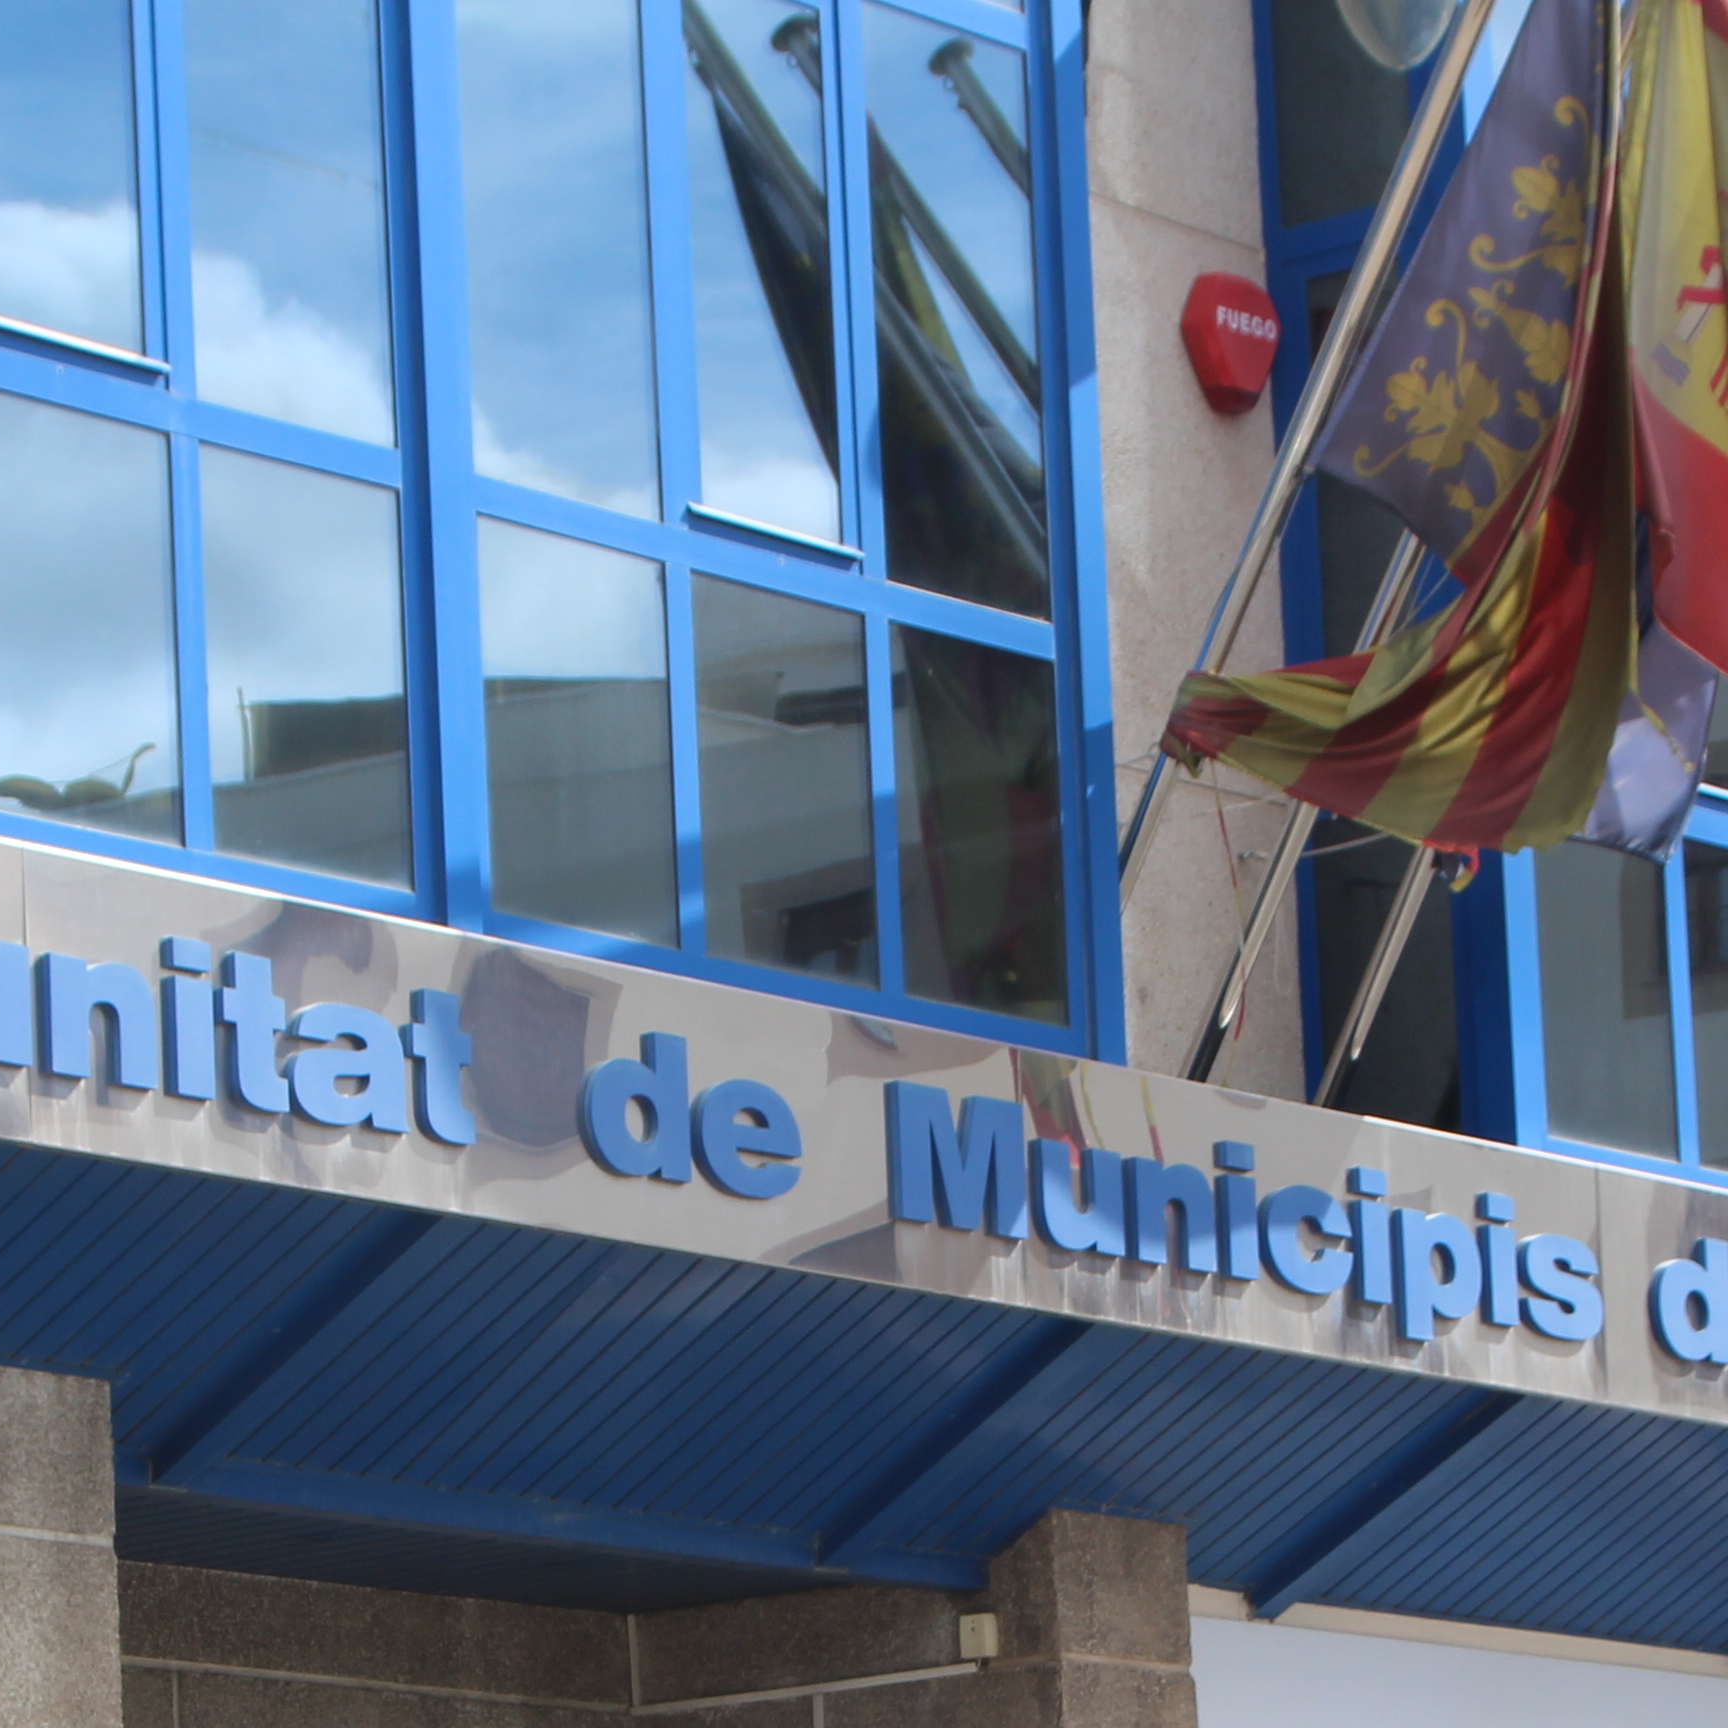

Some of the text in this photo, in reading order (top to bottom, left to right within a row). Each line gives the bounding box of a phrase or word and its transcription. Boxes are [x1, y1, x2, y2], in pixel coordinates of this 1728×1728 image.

[1216, 305, 1278, 342] FUEGO
[577, 1031, 803, 1200] de
[884, 1079, 1604, 1343] Municipis
